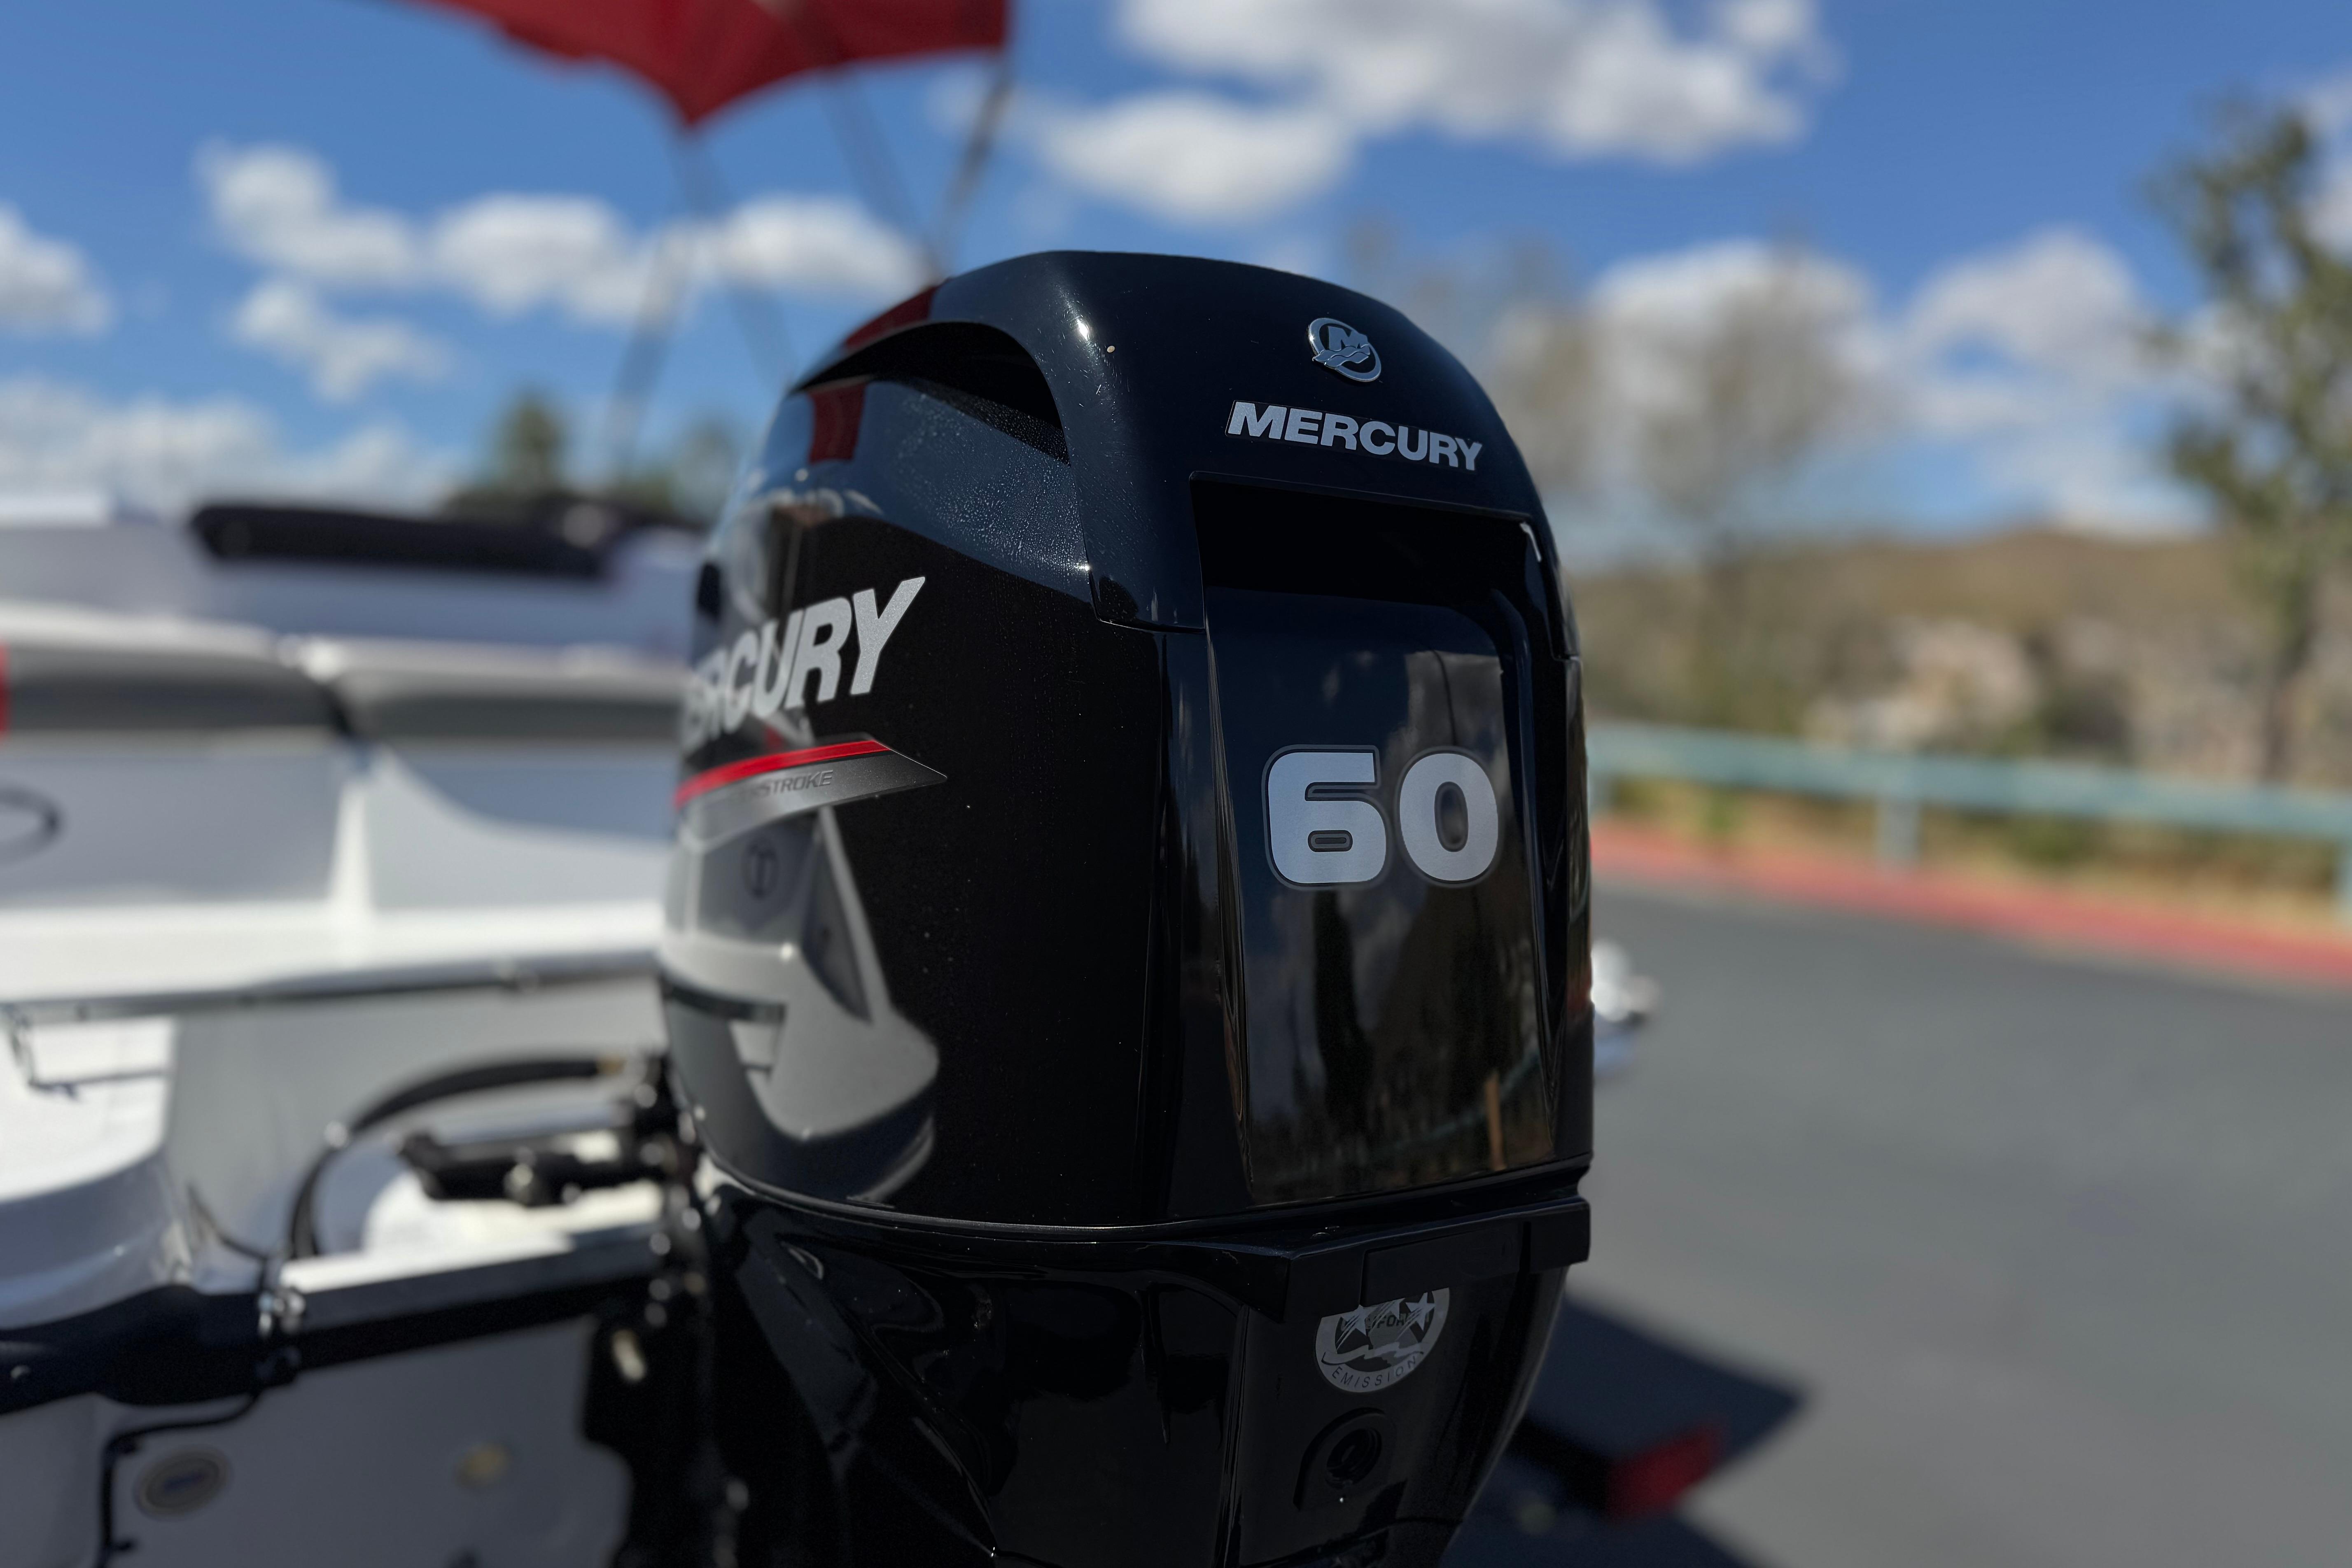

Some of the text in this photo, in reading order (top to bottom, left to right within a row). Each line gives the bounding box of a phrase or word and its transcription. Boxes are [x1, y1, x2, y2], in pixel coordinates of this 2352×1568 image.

[1228, 401, 1482, 471] MERCURY
[1264, 747, 1504, 888] 60
[1332, 1355, 1417, 1388] EMISSION
